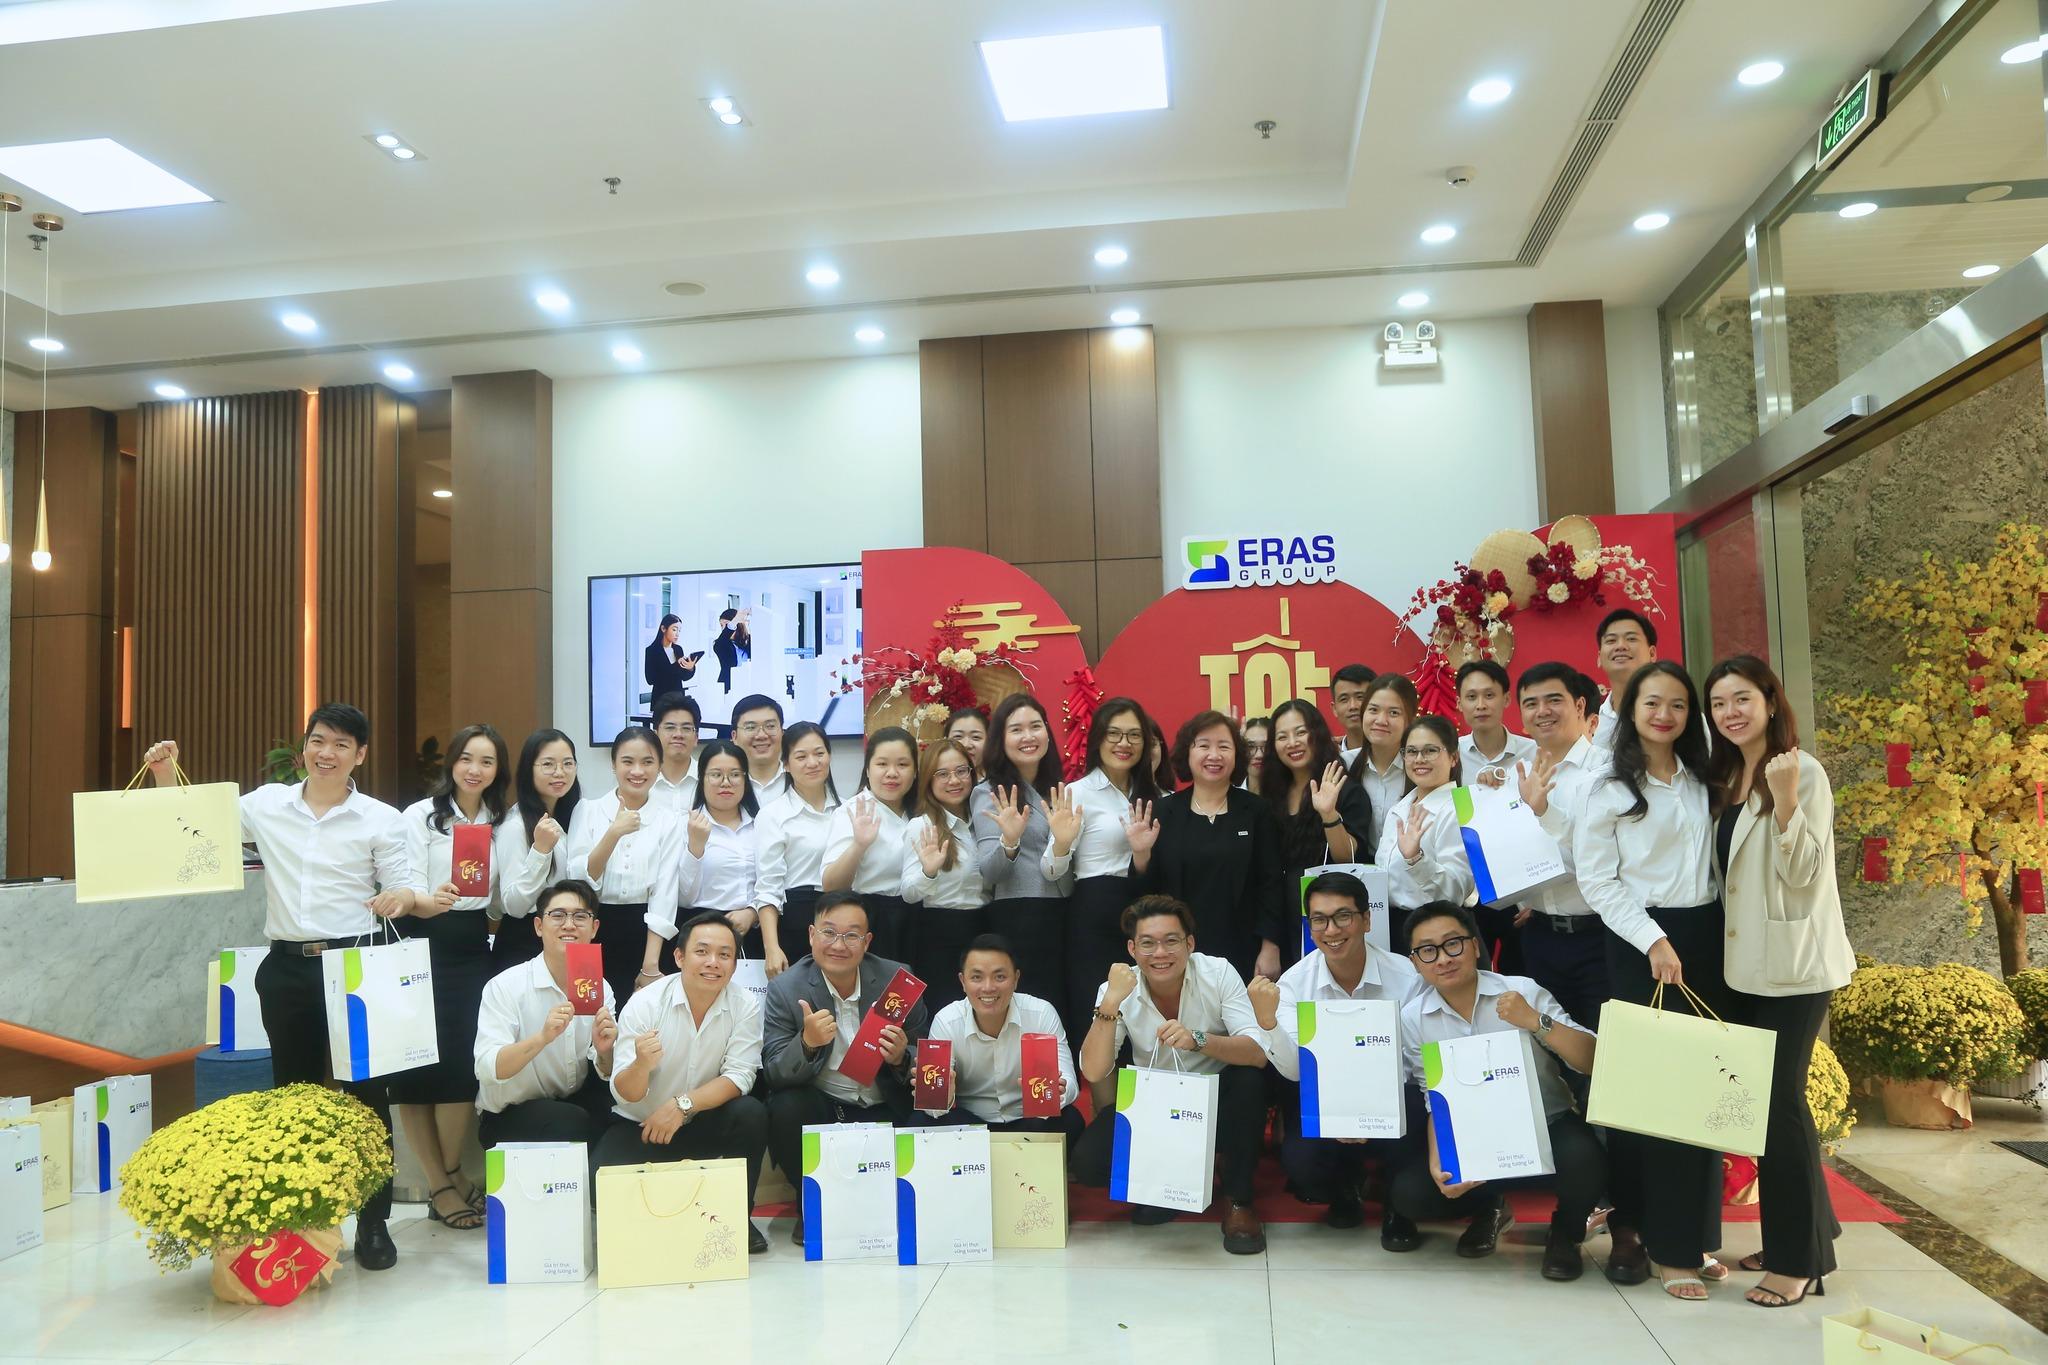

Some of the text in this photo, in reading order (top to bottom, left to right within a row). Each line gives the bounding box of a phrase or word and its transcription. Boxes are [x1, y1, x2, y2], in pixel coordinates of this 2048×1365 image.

[1845, 110, 1860, 132] EXIT
[1238, 535, 1335, 567] ERAS
[1240, 566, 1335, 580] GROUP
[1495, 1066, 1520, 1076] ERAS
[136, 1101, 149, 1110] ERAS
[1181, 1110, 1203, 1120] ERAS
[23, 1156, 38, 1167] ERAS
[868, 1161, 890, 1169] ERAS
